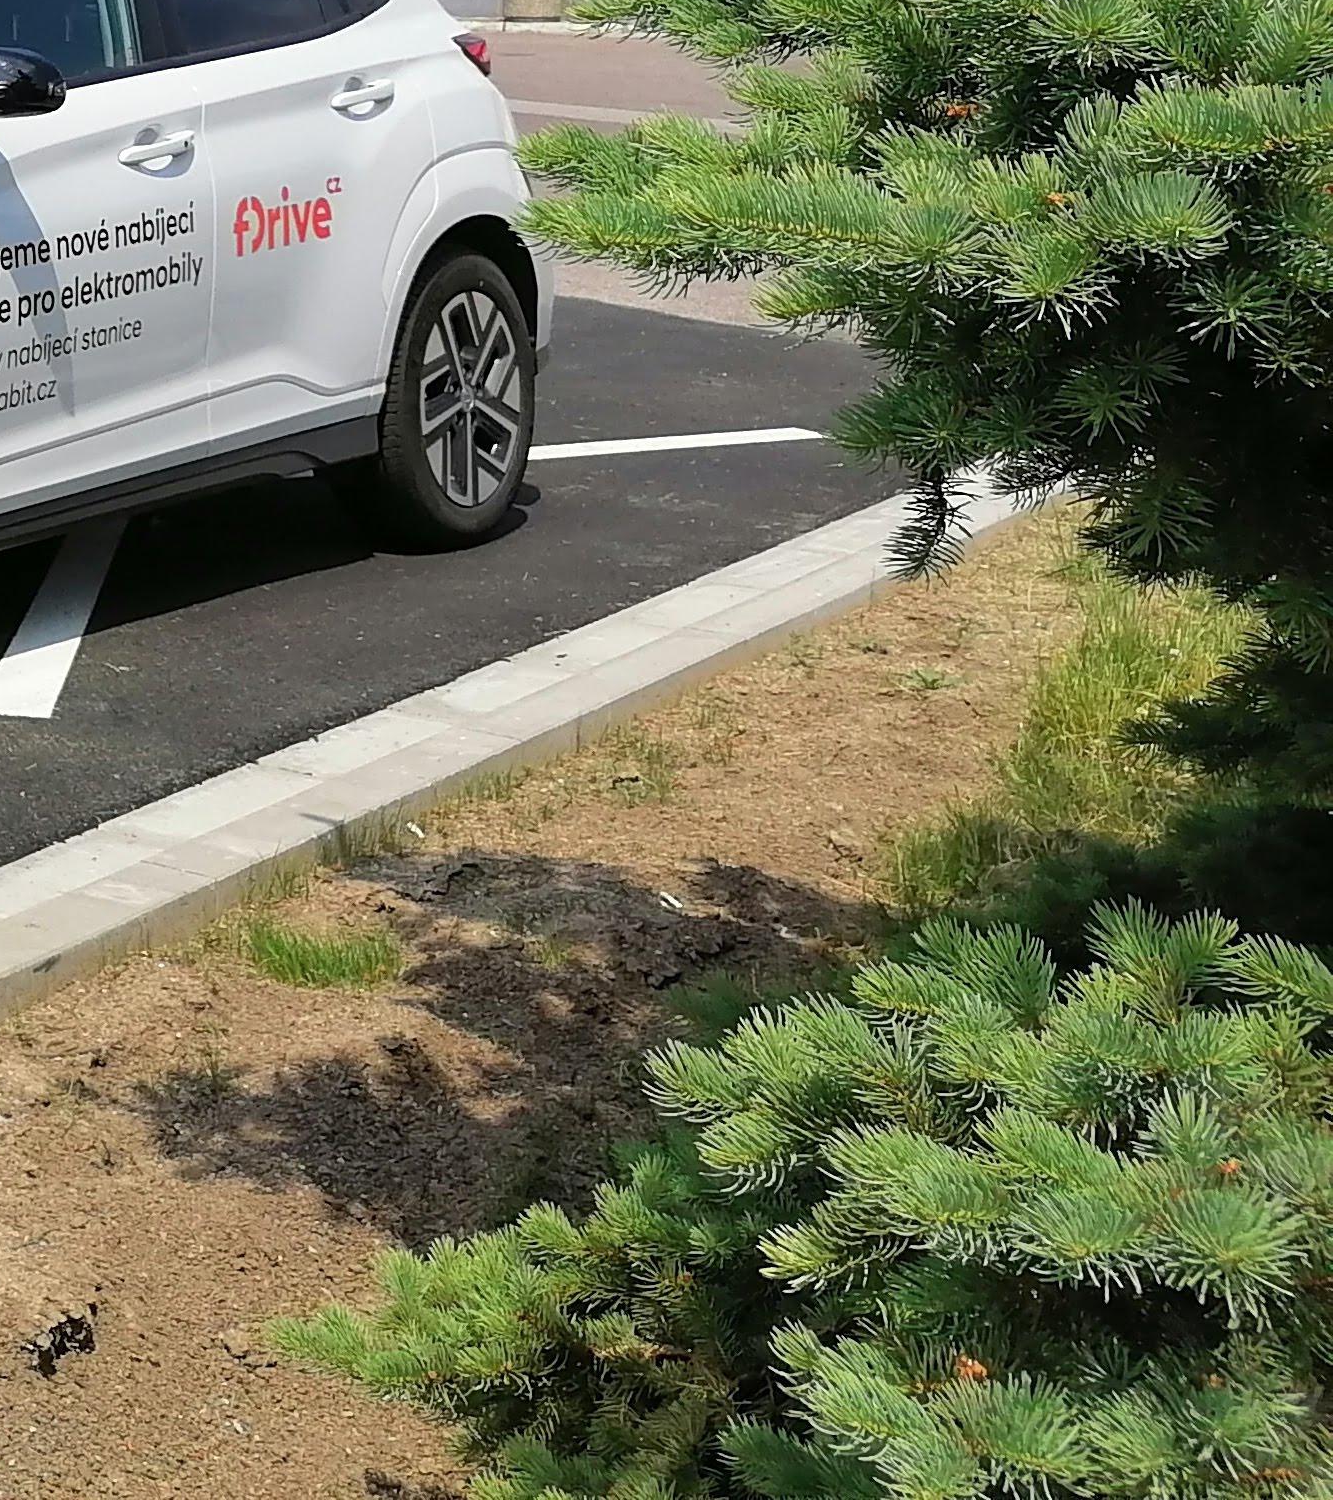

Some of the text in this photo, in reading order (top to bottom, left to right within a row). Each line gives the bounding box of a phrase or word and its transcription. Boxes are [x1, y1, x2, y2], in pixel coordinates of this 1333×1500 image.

[56, 219, 109, 260] nové
[115, 200, 195, 248] nabíjecí
[18, 290, 55, 326] pro
[61, 252, 203, 309] elektromobily
[7, 327, 79, 368] nabíjecí
[81, 317, 142, 351] stanice
